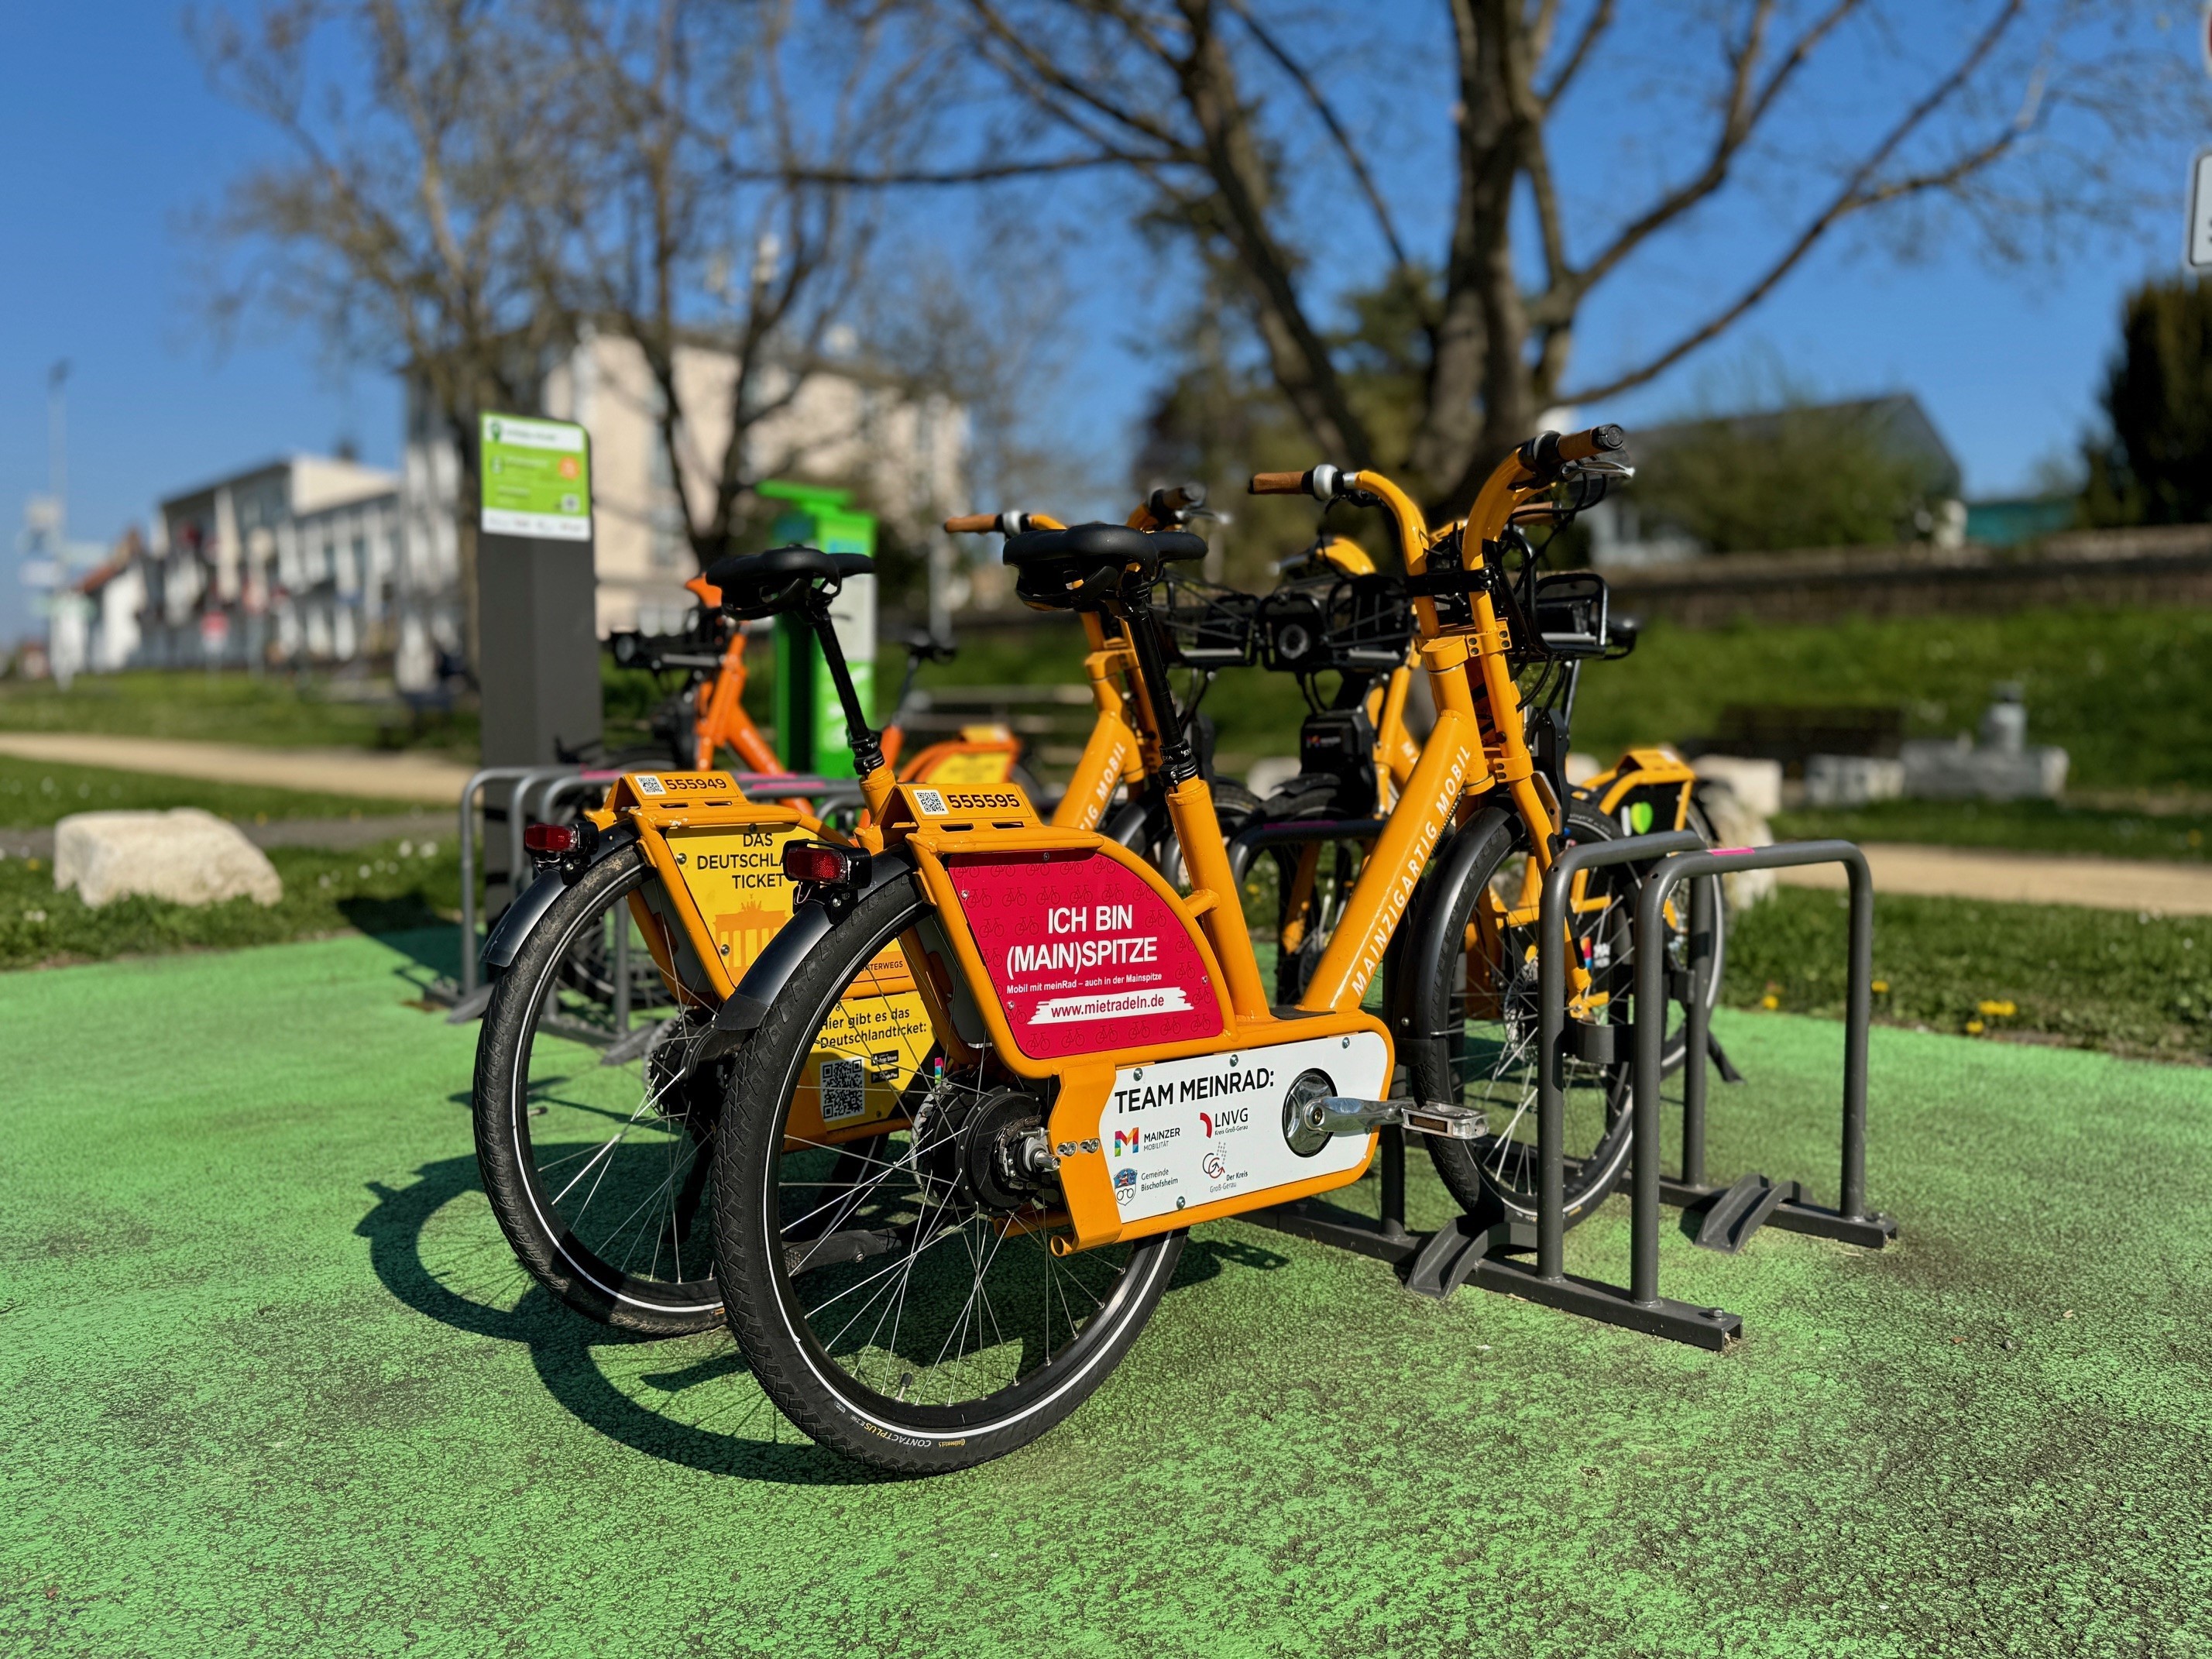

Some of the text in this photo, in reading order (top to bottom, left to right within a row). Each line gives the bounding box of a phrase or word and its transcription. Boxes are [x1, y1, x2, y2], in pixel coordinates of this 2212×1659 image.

[1096, 742, 1126, 801] MOBIL
[665, 777, 727, 790] 555949
[946, 792, 1020, 809] 555595
[743, 832, 773, 847] DAS
[1352, 745, 1471, 997] MAINZIGARTIG MOBIL
[732, 873, 785, 889] TICKET
[1048, 904, 1133, 934] ICH BIN
[861, 960, 903, 971] TERWEGS
[1007, 936, 1158, 980] (MAIN)SPITZE
[1007, 984, 1029, 994] Mobil
[1030, 982, 1042, 992] mit
[1044, 979, 1077, 991] meinRad
[1084, 977, 1103, 987] auch
[1104, 976, 1111, 985] in
[1112, 974, 1125, 984] der
[1126, 972, 1163, 983] Mainspitze
[1051, 993, 1165, 1018] www.mietradeln.de
[847, 1012, 871, 1029] gibt
[875, 1012, 888, 1022] es
[891, 1008, 910, 1020] das
[820, 1022, 927, 1050] Deutschlandticket:
[1115, 1067, 1275, 1114] TEAM MEINRAD:
[1214, 1108, 1249, 1128] LNVG
[1144, 1127, 1180, 1143] MAINZER
[1143, 1139, 1170, 1152] MOBILITÄT
[1141, 1168, 1169, 1180] Gemeinde
[1236, 1170, 1249, 1179] Kreis
[1141, 1176, 1178, 1192] Bischofsheim
[1209, 1182, 1237, 1194] Groß-Gerau
[864, 1422, 932, 1447] CONTACTPLUS
